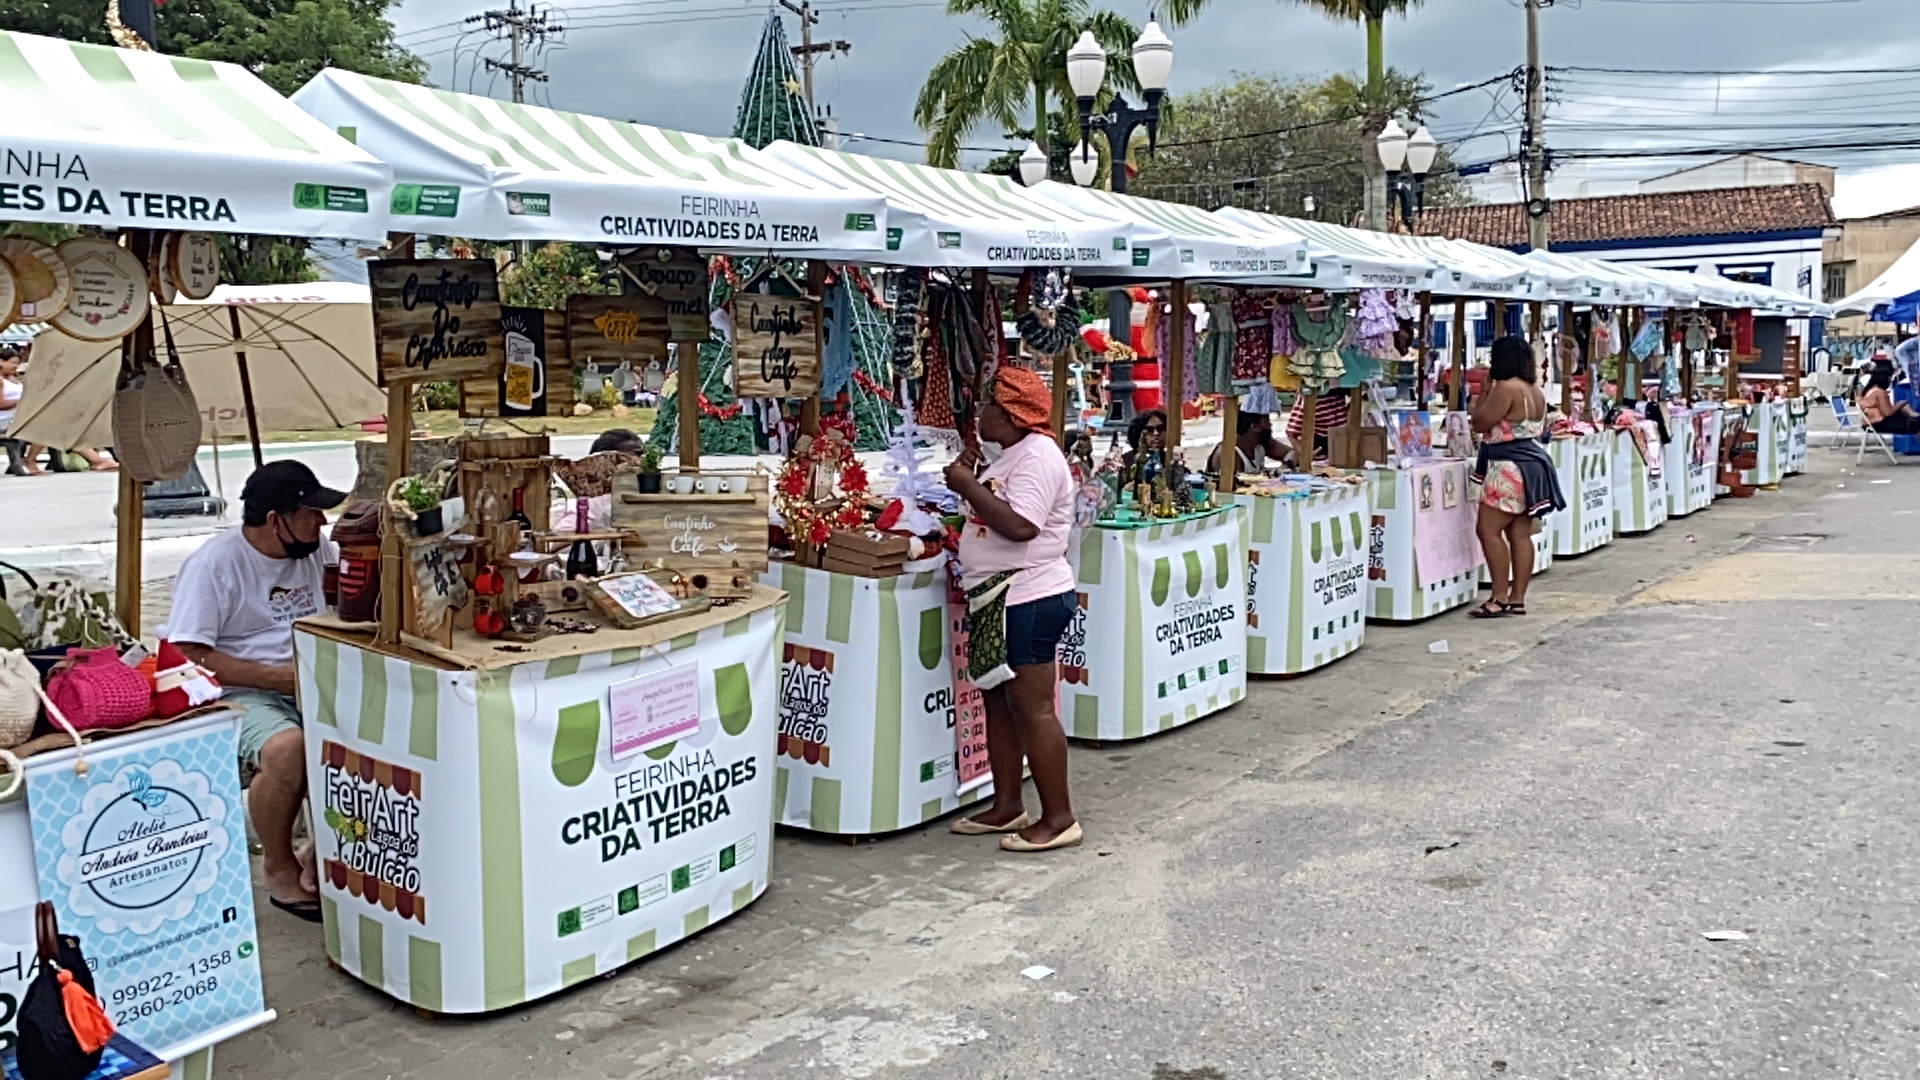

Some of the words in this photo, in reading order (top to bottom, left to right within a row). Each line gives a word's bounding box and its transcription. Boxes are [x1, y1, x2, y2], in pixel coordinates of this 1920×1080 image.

[57, 186, 111, 216] DA
[120, 190, 237, 223] TERRA
[680, 194, 761, 220] FEIRINHA
[600, 215, 741, 240] CRIATIVIDADES
[744, 223, 767, 241] DA
[771, 223, 820, 243] TERRA
[1026, 229, 1070, 245] FEIRINHA
[987, 246, 1062, 262] CRIATIVIDADES
[1063, 247, 1076, 261] DA
[1077, 248, 1102, 262] TERRA
[402, 268, 480, 310] Cantinho
[751, 302, 804, 340] Cantinho
[663, 514, 716, 532] Cantinho
[1313, 563, 1364, 594] CRIATIVIDADES
[1323, 590, 1334, 606] DA
[1334, 581, 1358, 601] TERRA
[1173, 594, 1213, 619] FEIRINHA
[1155, 604, 1235, 643] CRIATIVIDADES
[1168, 637, 1185, 657] DA
[1187, 624, 1223, 650] TERRA
[813, 701, 828, 717] do
[614, 748, 717, 799] FEIRINHA
[561, 755, 757, 845] CRIATIVIDADES
[144, 828, 209, 857] Bandeira
[370, 826, 401, 851] Lagoa
[402, 838, 418, 857] do
[601, 826, 642, 863] DA
[648, 794, 731, 845] TERRA
[108, 856, 188, 889] Artesanatos
[352, 840, 420, 894] Bulcão
[112, 970, 182, 1006] 99922-
[188, 949, 232, 977] 1358
[115, 975, 218, 1028] 2360-2068
